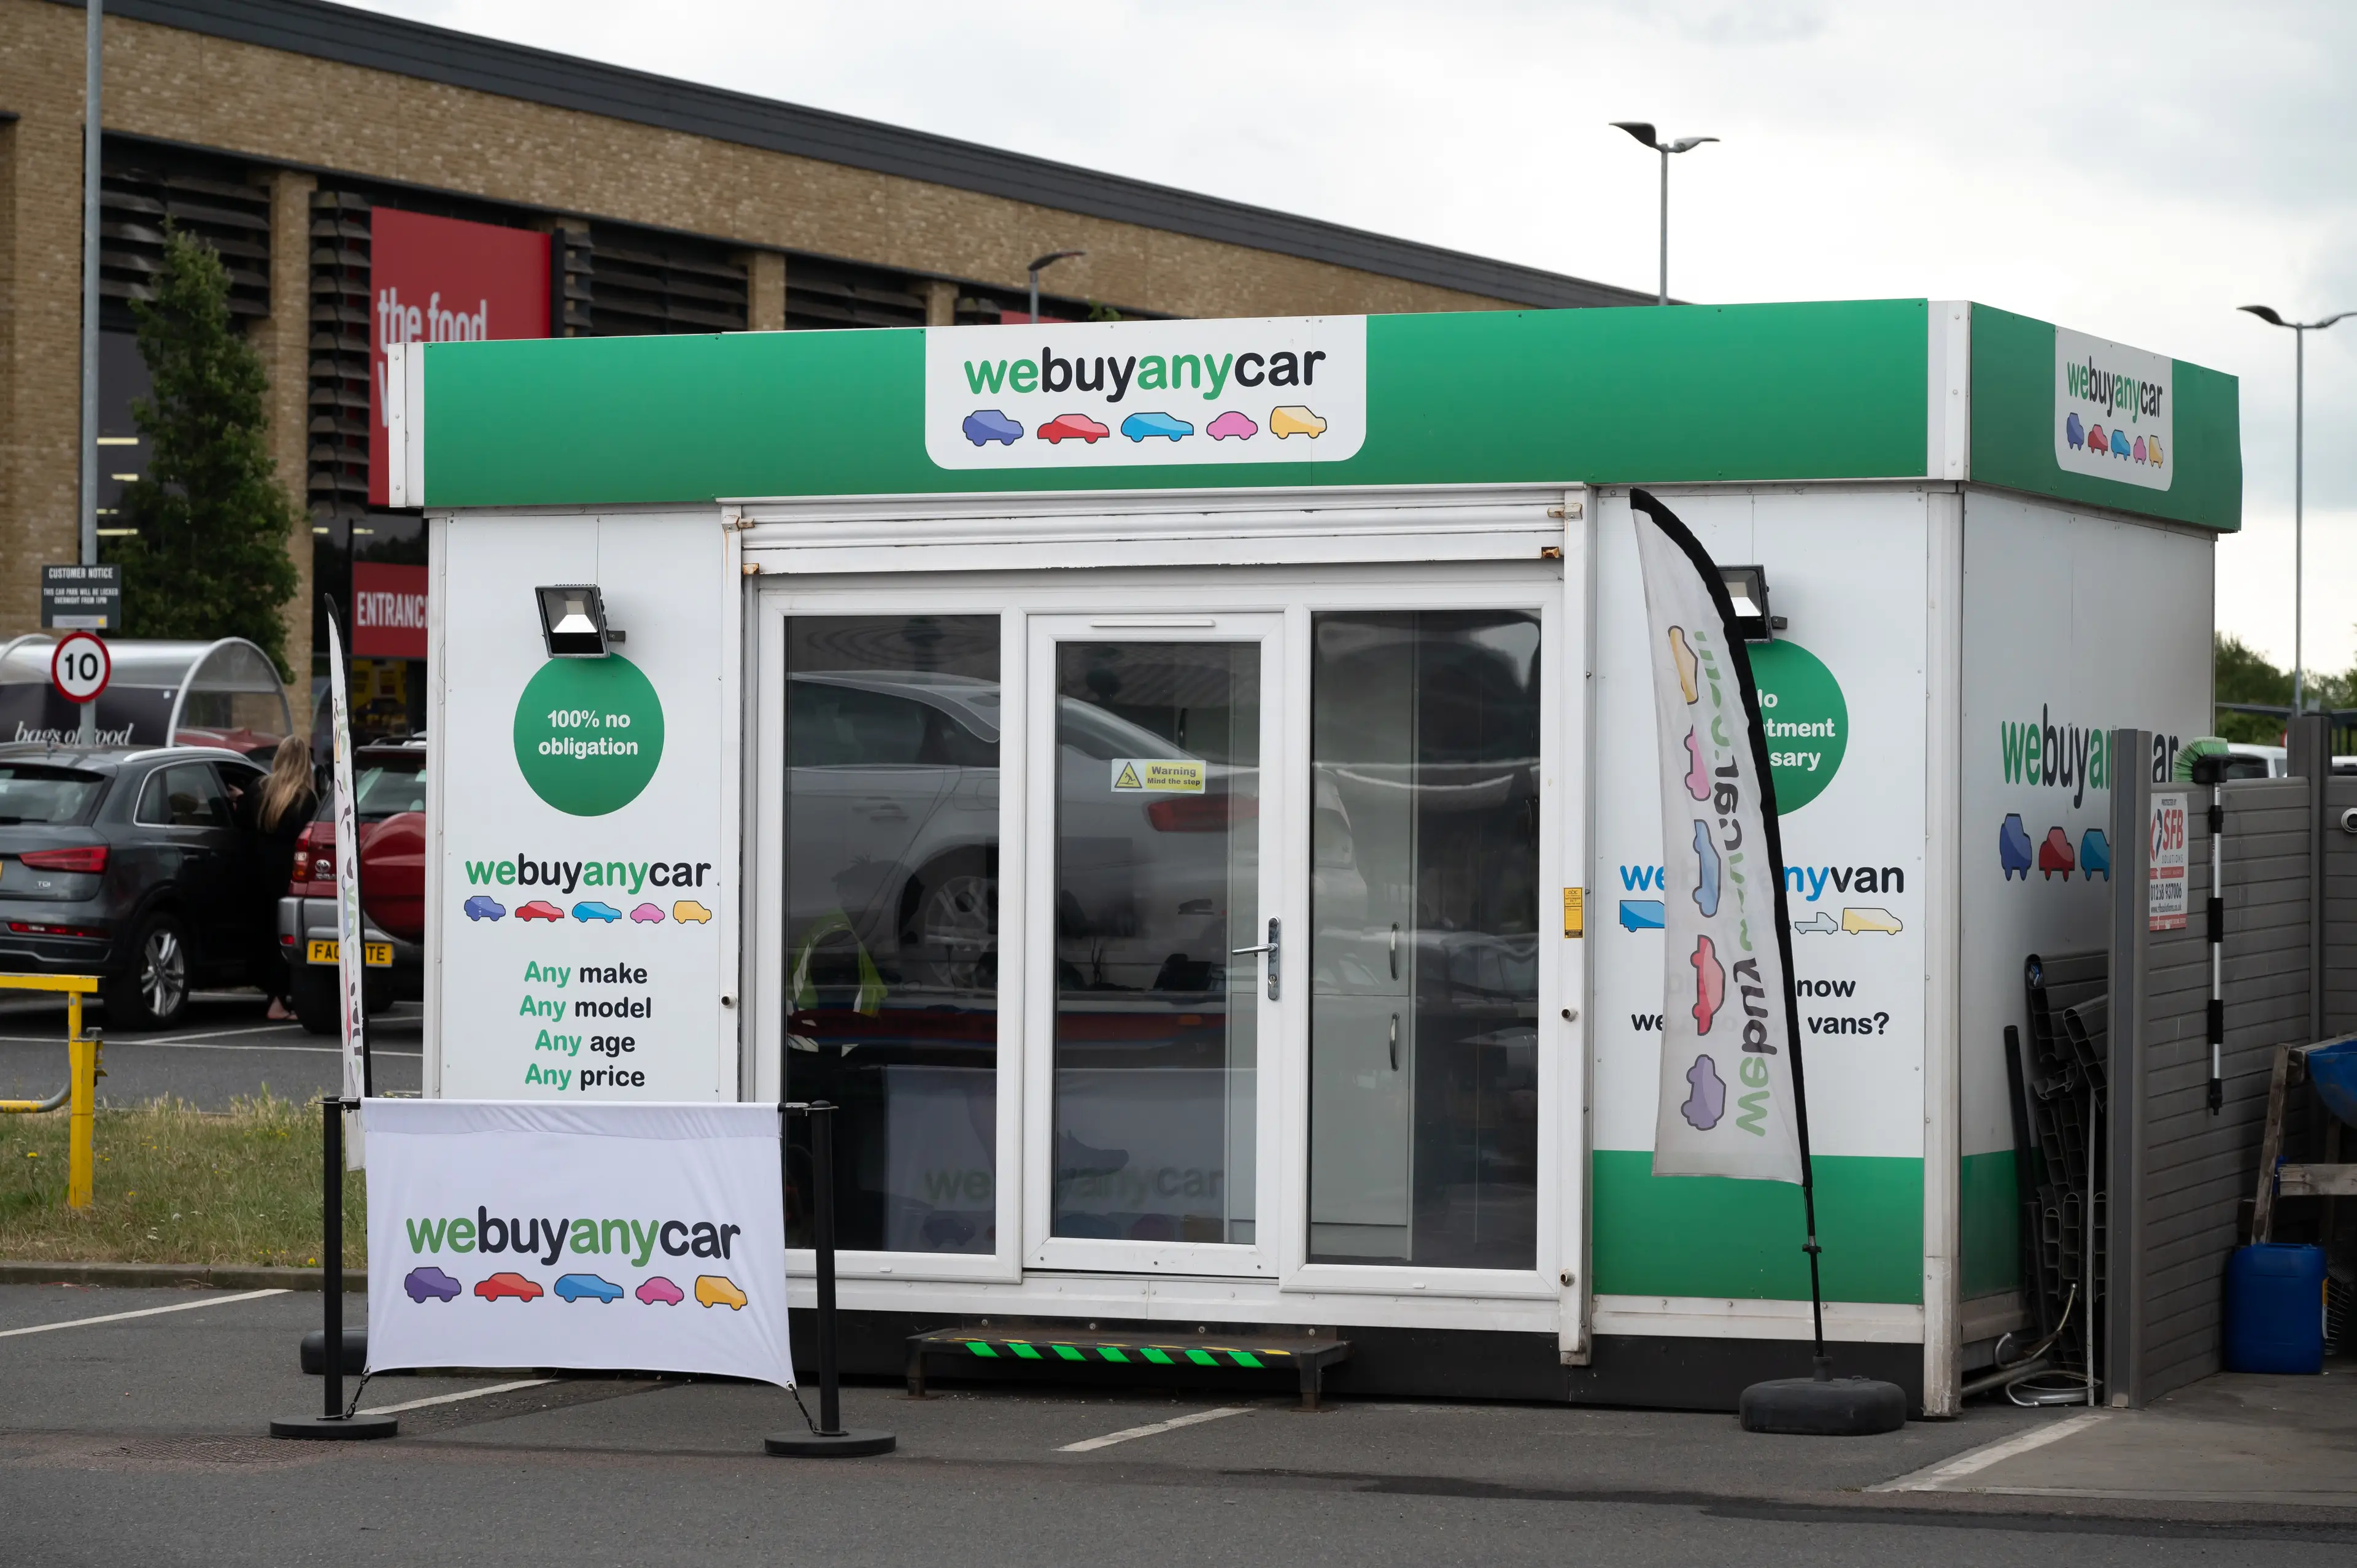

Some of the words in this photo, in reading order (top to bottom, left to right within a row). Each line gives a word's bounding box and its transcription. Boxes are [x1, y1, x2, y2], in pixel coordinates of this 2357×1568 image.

[377, 287, 422, 354] the
[427, 292, 487, 341] food
[964, 347, 1326, 403] webuyanycar
[2067, 355, 2162, 423] webuyanycar
[48, 567, 86, 579] CUSTOMER
[88, 567, 114, 579] NOTICE
[64, 653, 98, 681] 10
[548, 709, 599, 728] 100%
[606, 714, 630, 728] no
[95, 722, 134, 746] ood
[538, 737, 638, 759] obligation
[1151, 766, 1196, 778] Warning
[2162, 809, 2183, 851] SFB
[2162, 854, 2183, 863] SOLUTIONS
[465, 853, 711, 894] webuyanycar
[524, 961, 571, 988] Any
[579, 962, 648, 984] make
[1797, 978, 1857, 998] now
[519, 995, 566, 1022] Any
[575, 997, 651, 1019] model
[1808, 1011, 1890, 1035] vans?
[535, 1029, 582, 1057] Any
[590, 1036, 636, 1058] age
[525, 1063, 571, 1091] Any
[581, 1065, 645, 1091] price
[406, 1206, 741, 1267] webuyanycar
